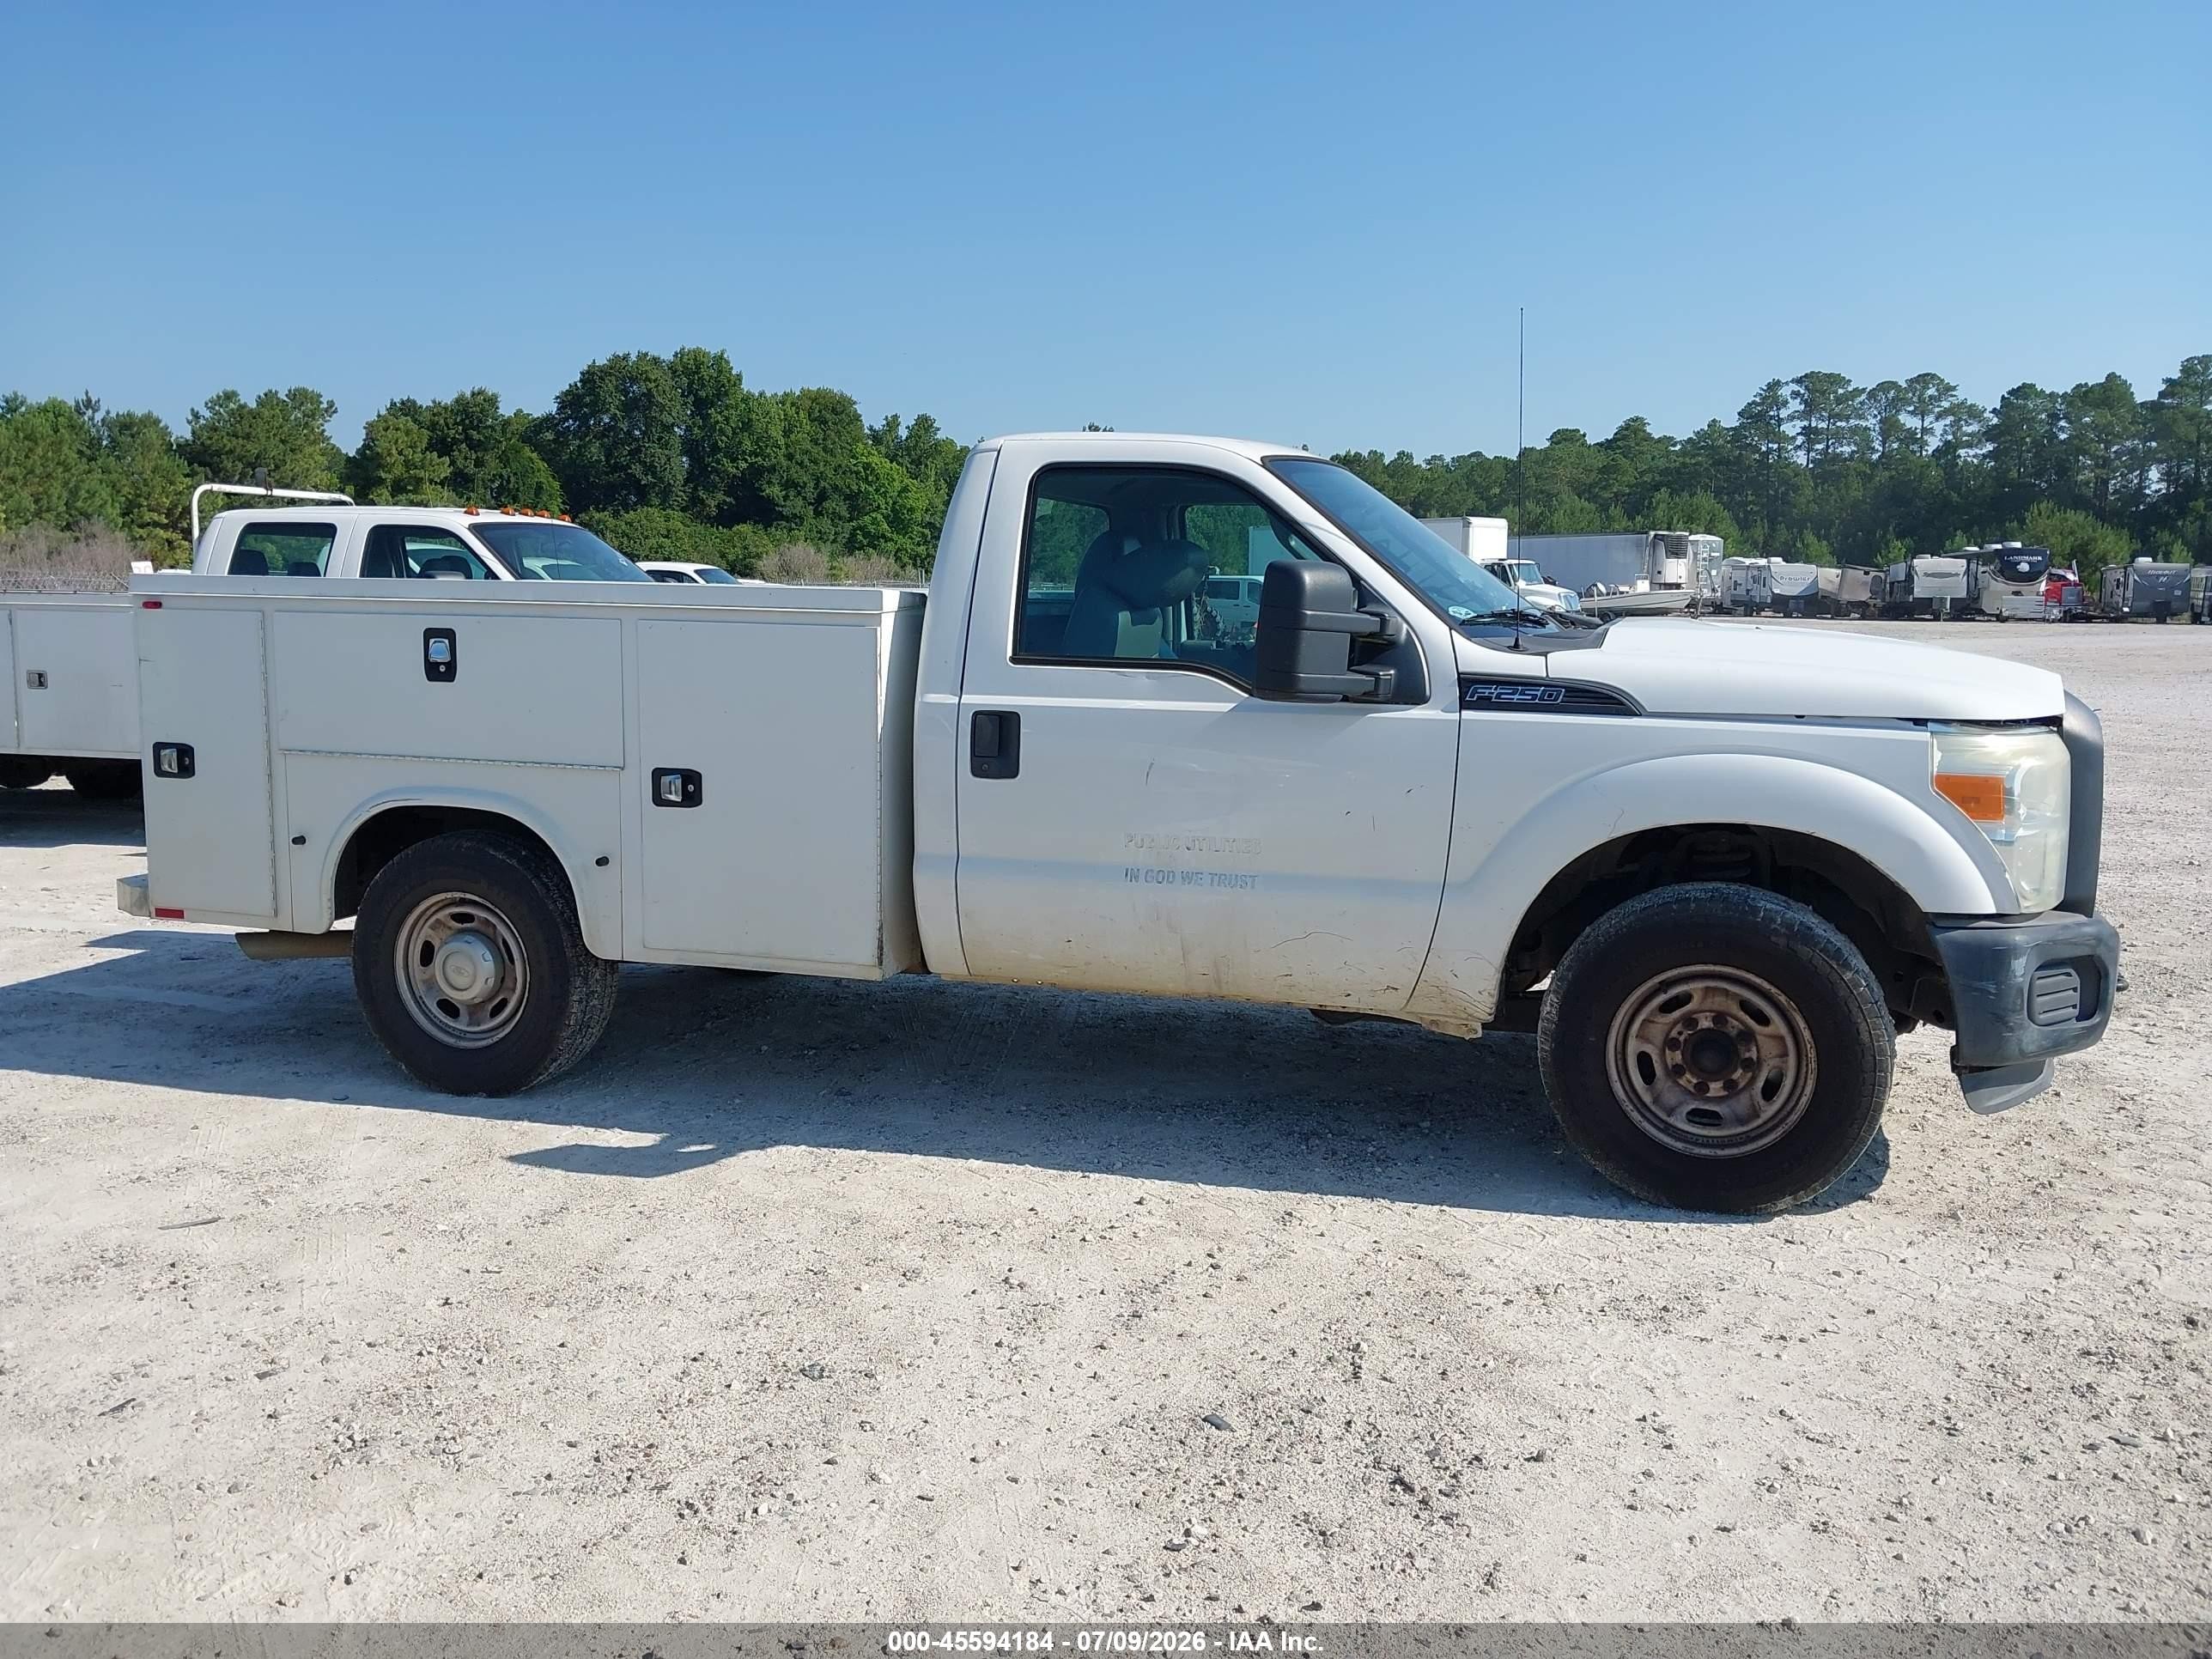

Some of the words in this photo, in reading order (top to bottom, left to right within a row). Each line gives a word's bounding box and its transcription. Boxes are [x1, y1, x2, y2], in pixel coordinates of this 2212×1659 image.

[1124, 833, 1180, 851] PUBLIC
[1184, 836, 1263, 854] UTILITIES
[1124, 867, 1140, 884] IN
[1144, 869, 1176, 884] GOD
[1181, 871, 1203, 886] WE
[1208, 872, 1259, 890] TRUST
